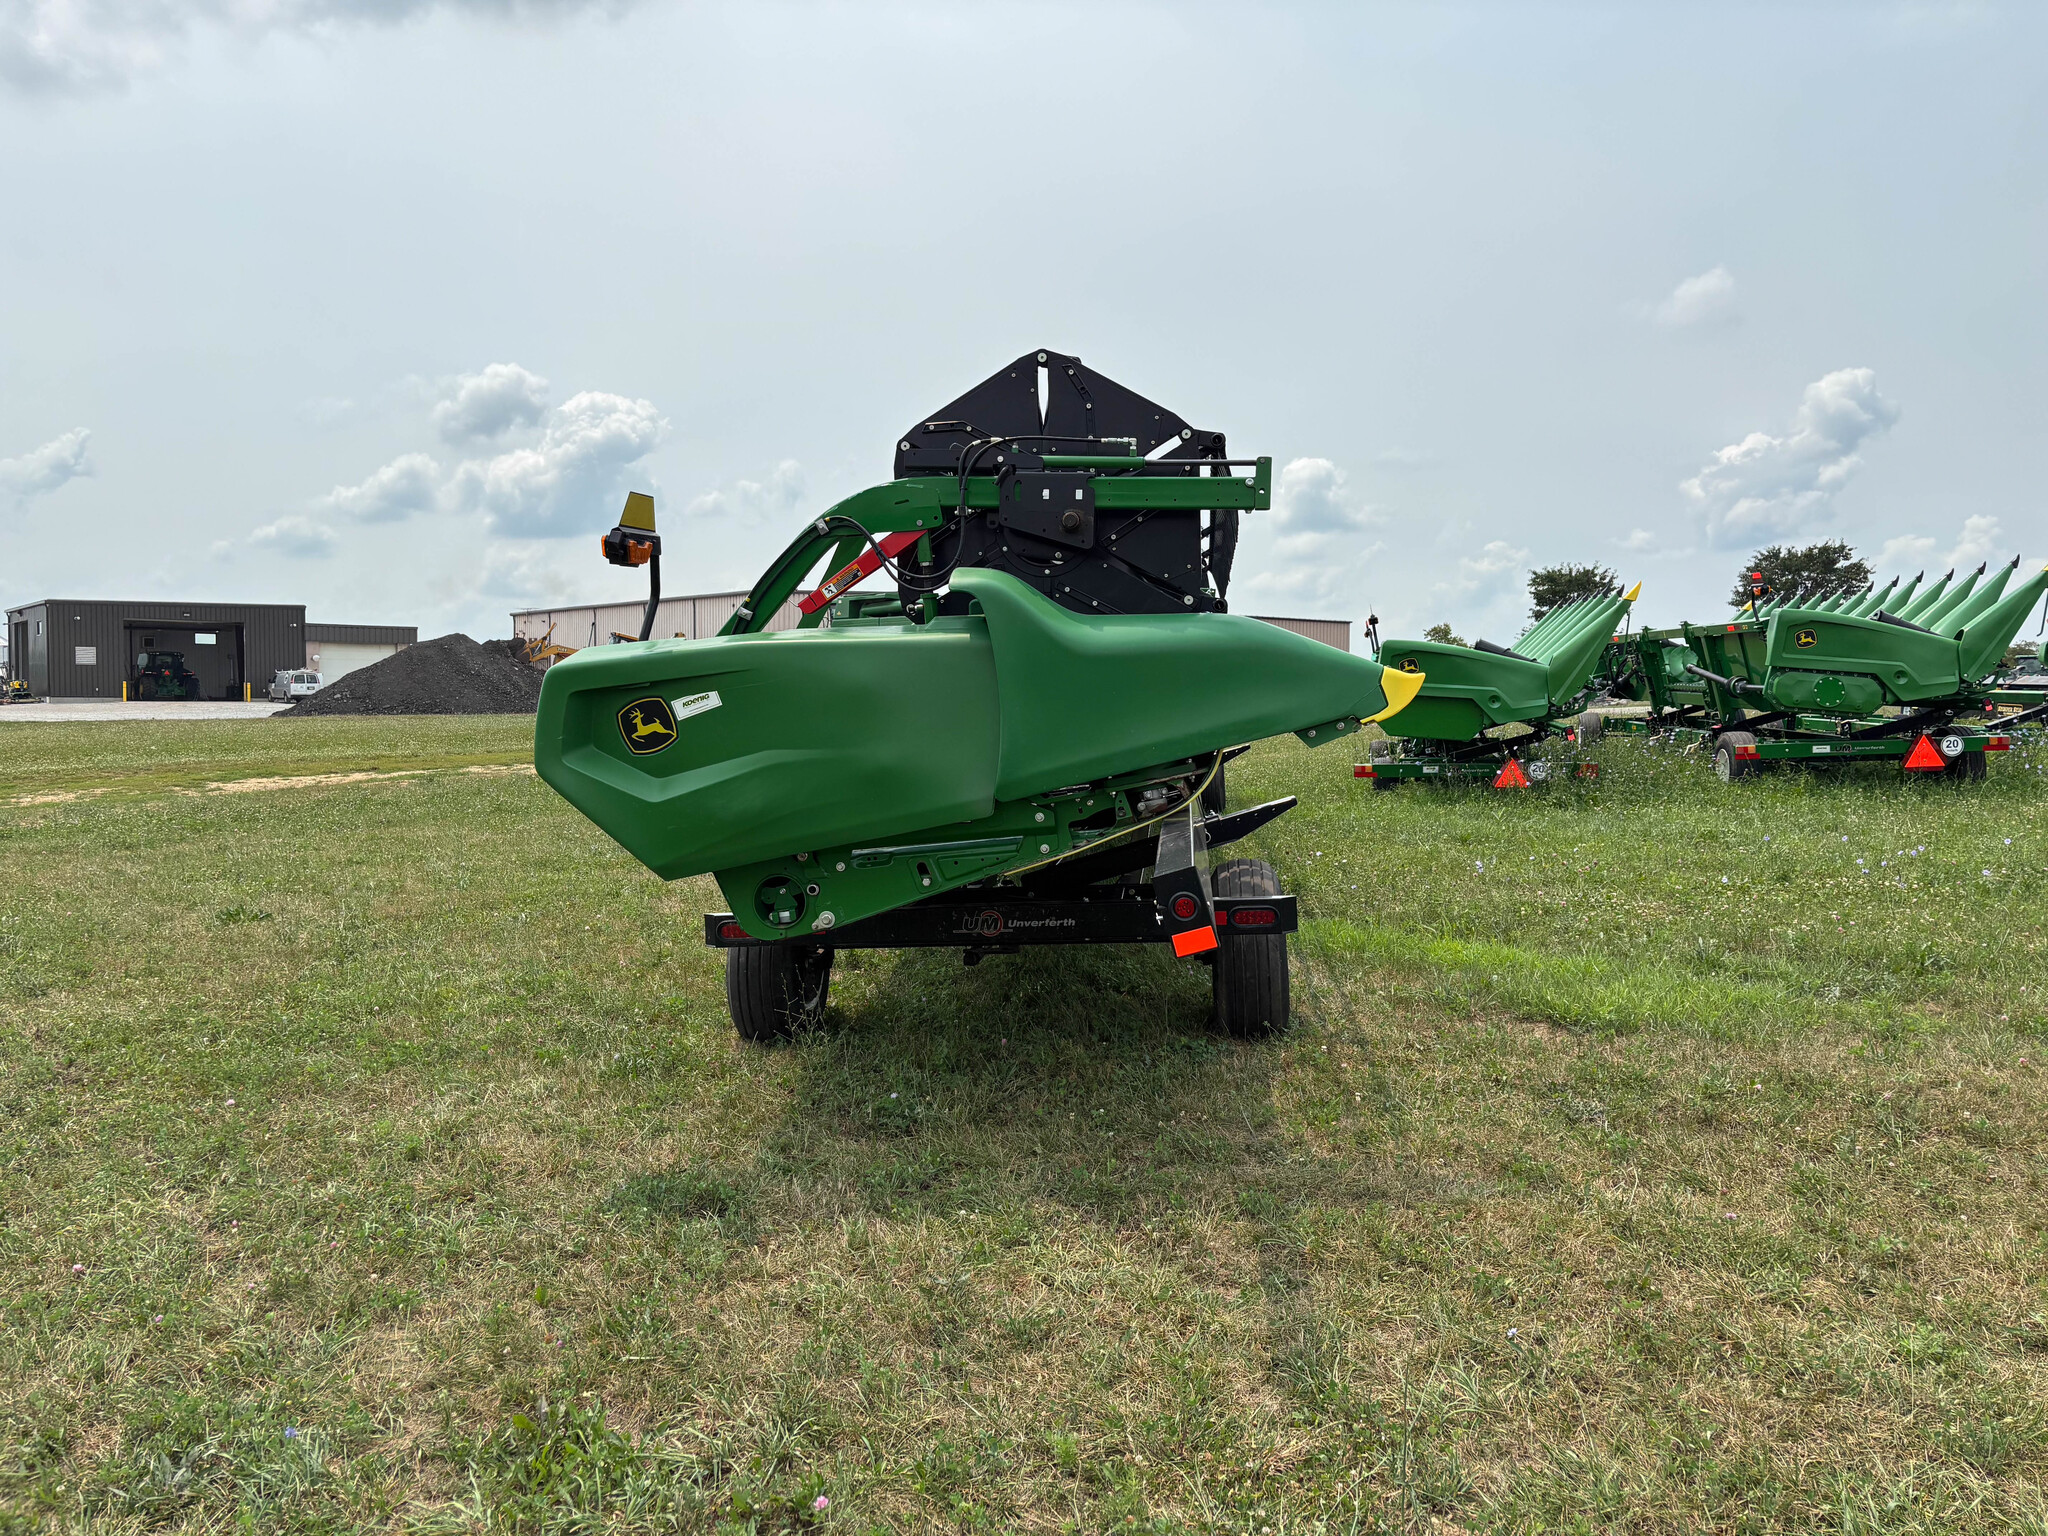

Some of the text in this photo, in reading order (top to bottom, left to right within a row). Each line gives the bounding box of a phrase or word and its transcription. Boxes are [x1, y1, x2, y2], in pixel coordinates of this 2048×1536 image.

[1945, 739, 1959, 749] 20
[1532, 764, 1545, 773] 20
[962, 914, 1076, 932] UM Unverferth
